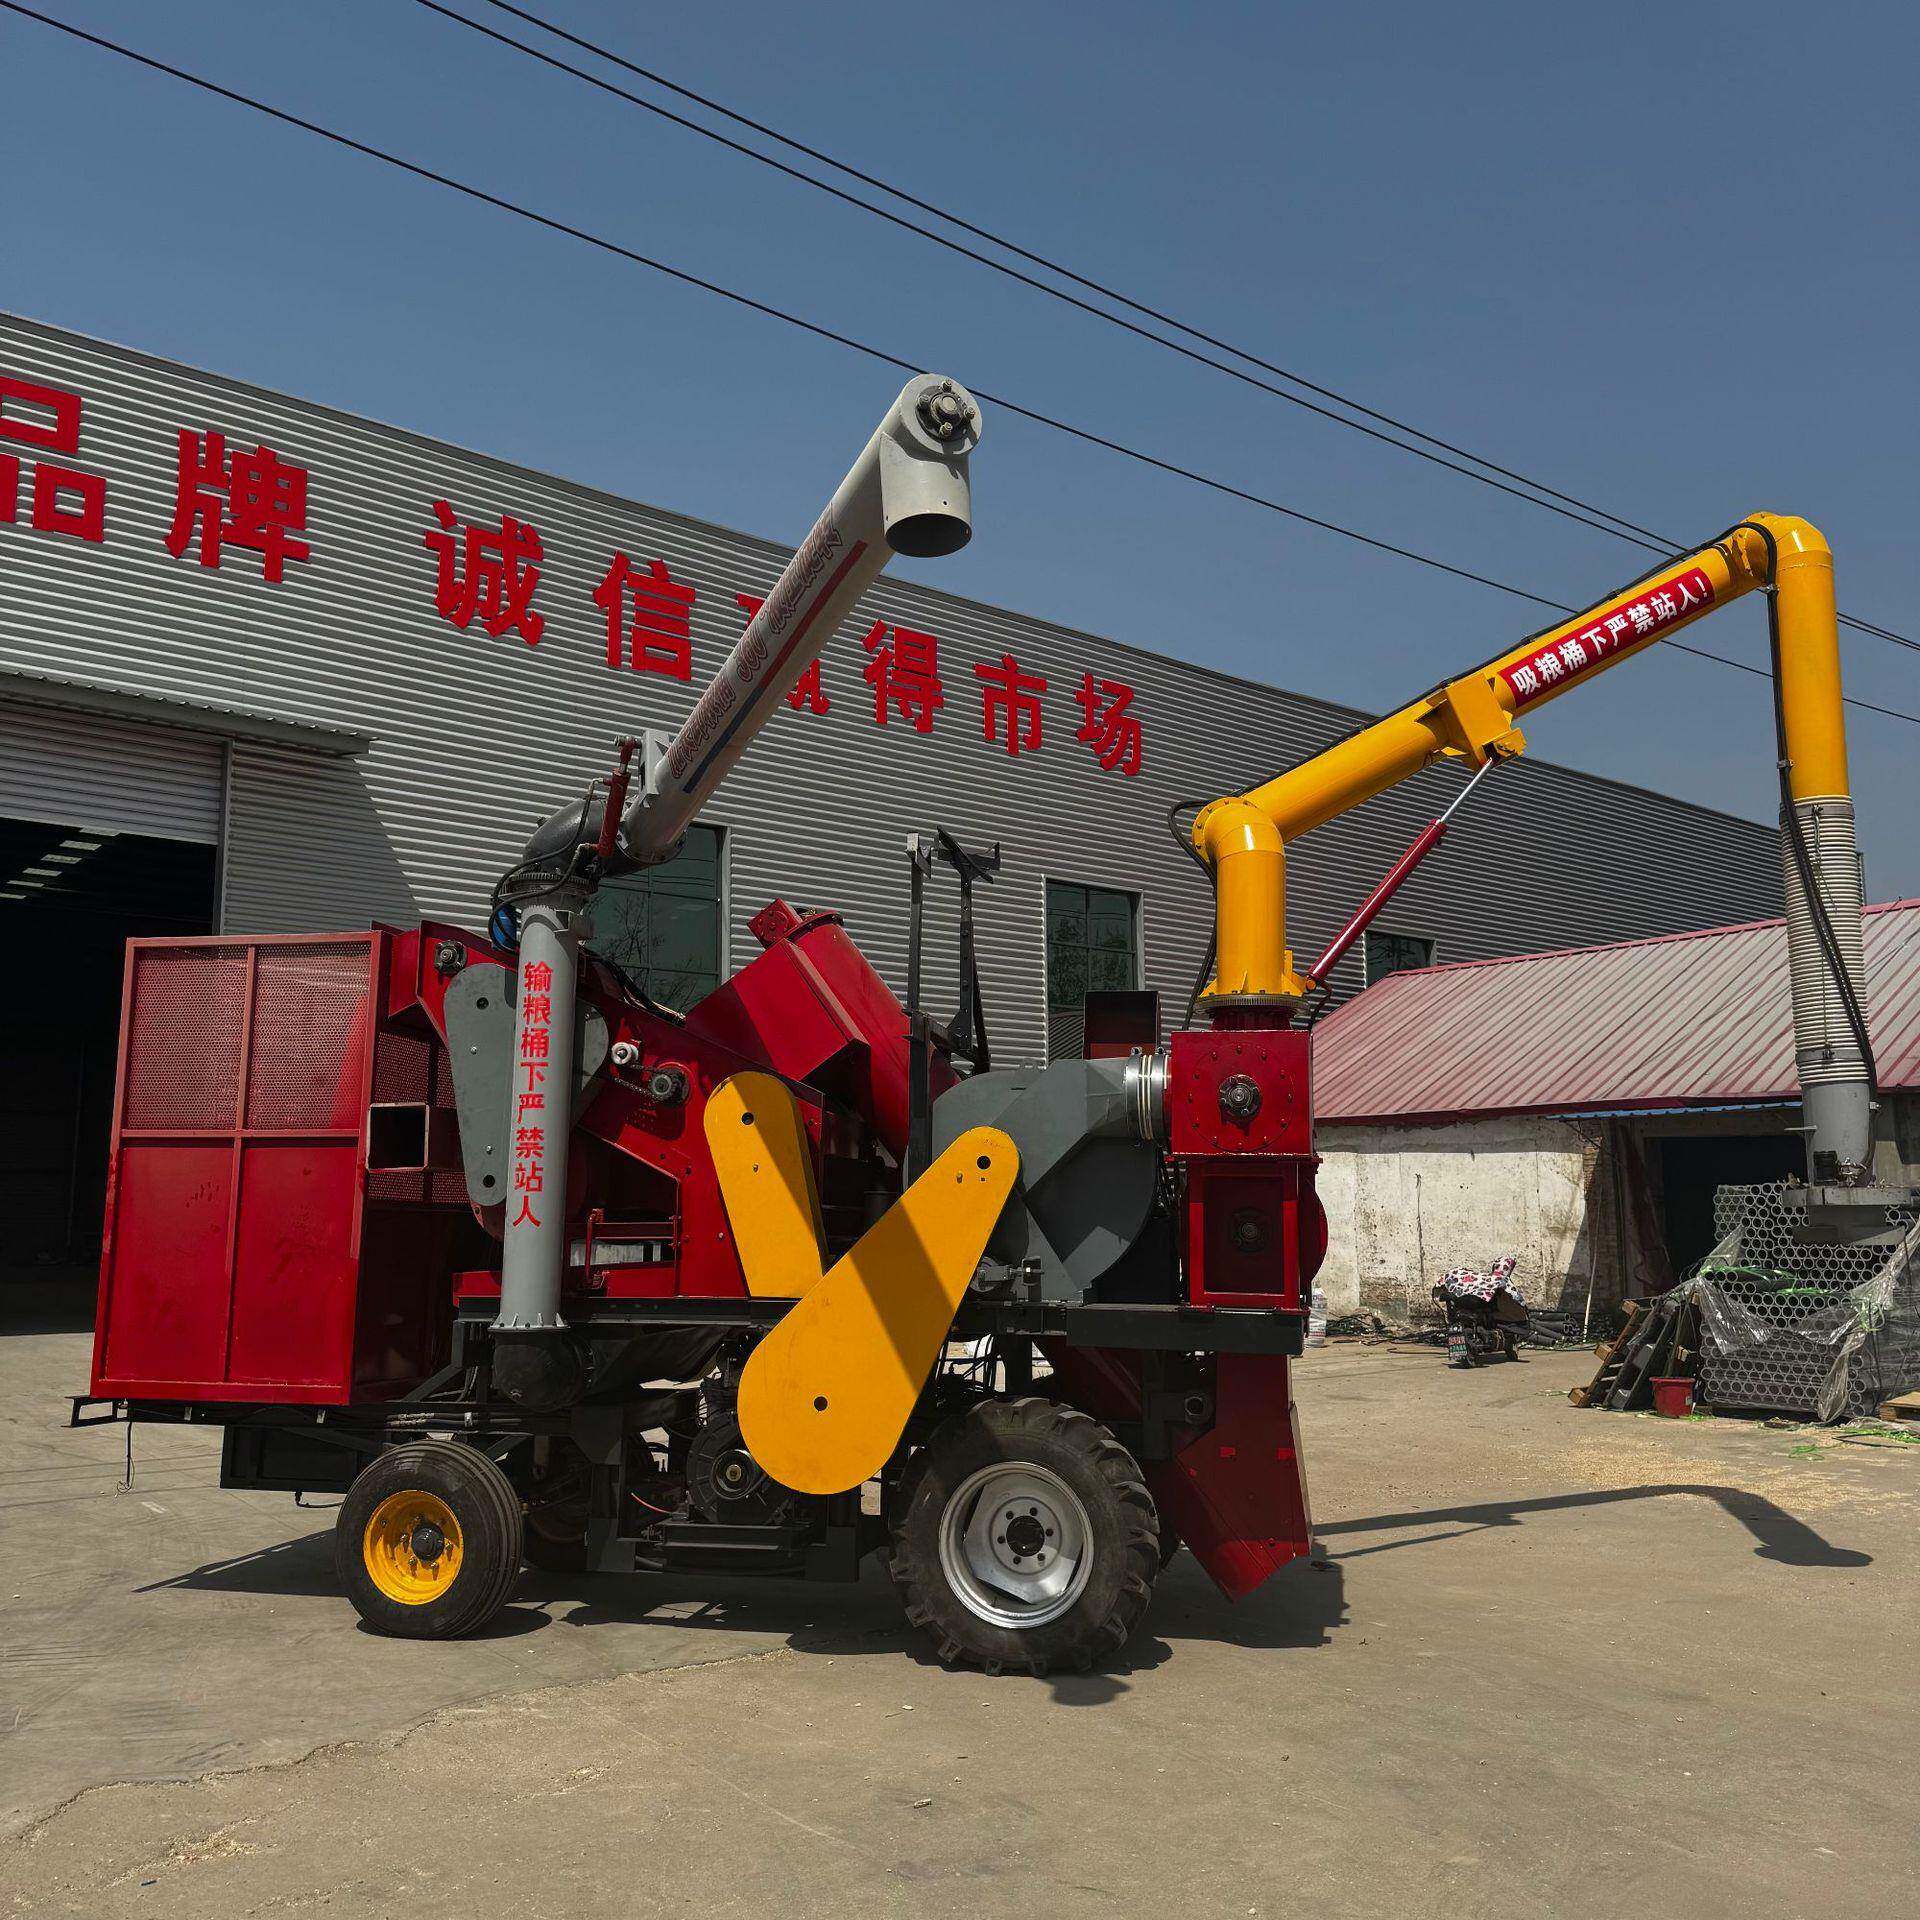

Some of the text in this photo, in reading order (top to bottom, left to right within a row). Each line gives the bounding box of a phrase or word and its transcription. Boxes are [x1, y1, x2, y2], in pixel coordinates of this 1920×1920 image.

[511, 961, 554, 1228] 输粮桶下严禁站人
